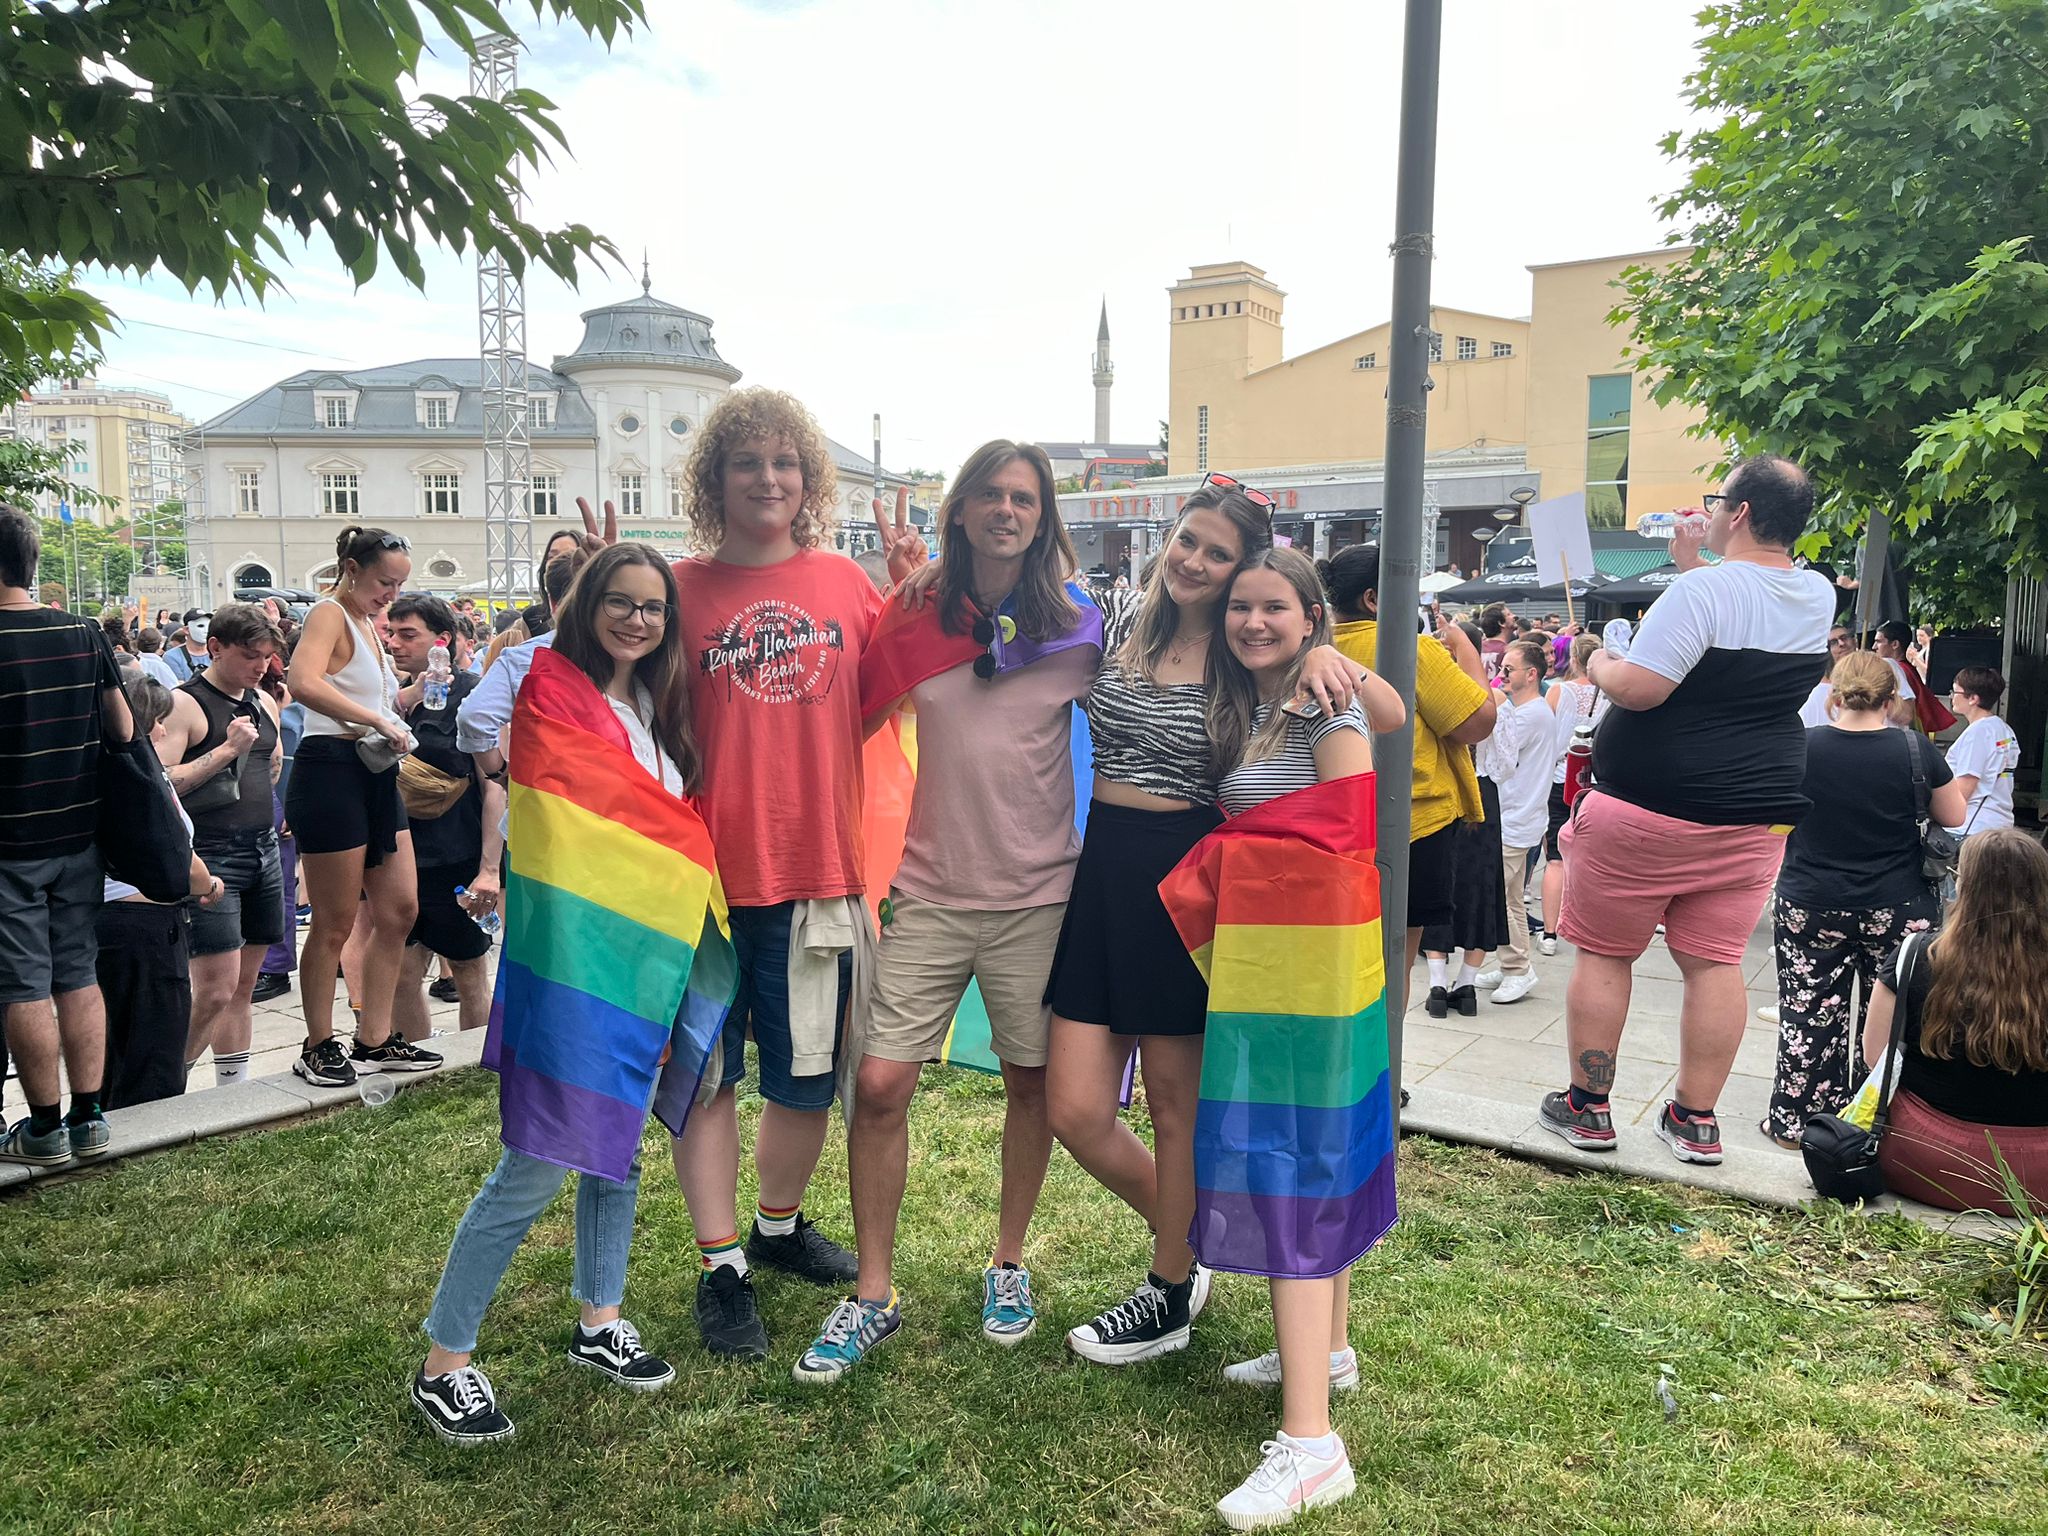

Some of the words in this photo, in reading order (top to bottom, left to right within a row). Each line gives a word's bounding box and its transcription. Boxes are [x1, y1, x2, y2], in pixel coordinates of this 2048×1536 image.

[620, 529, 652, 539] UNITED
[722, 611, 744, 645] WAIKIKI
[745, 599, 787, 615] HISTORIC
[789, 603, 816, 626] TRAILS
[764, 611, 789, 620] MAUNA
[708, 638, 757, 678] Royal
[764, 627, 838, 662] Hawaiian
[817, 650, 827, 669] ONE
[758, 654, 806, 689] Beach
[804, 671, 821, 691] VISIT
[731, 672, 761, 701] ENOUGH
[795, 690, 803, 698] IS
[763, 692, 793, 704] NEVER
